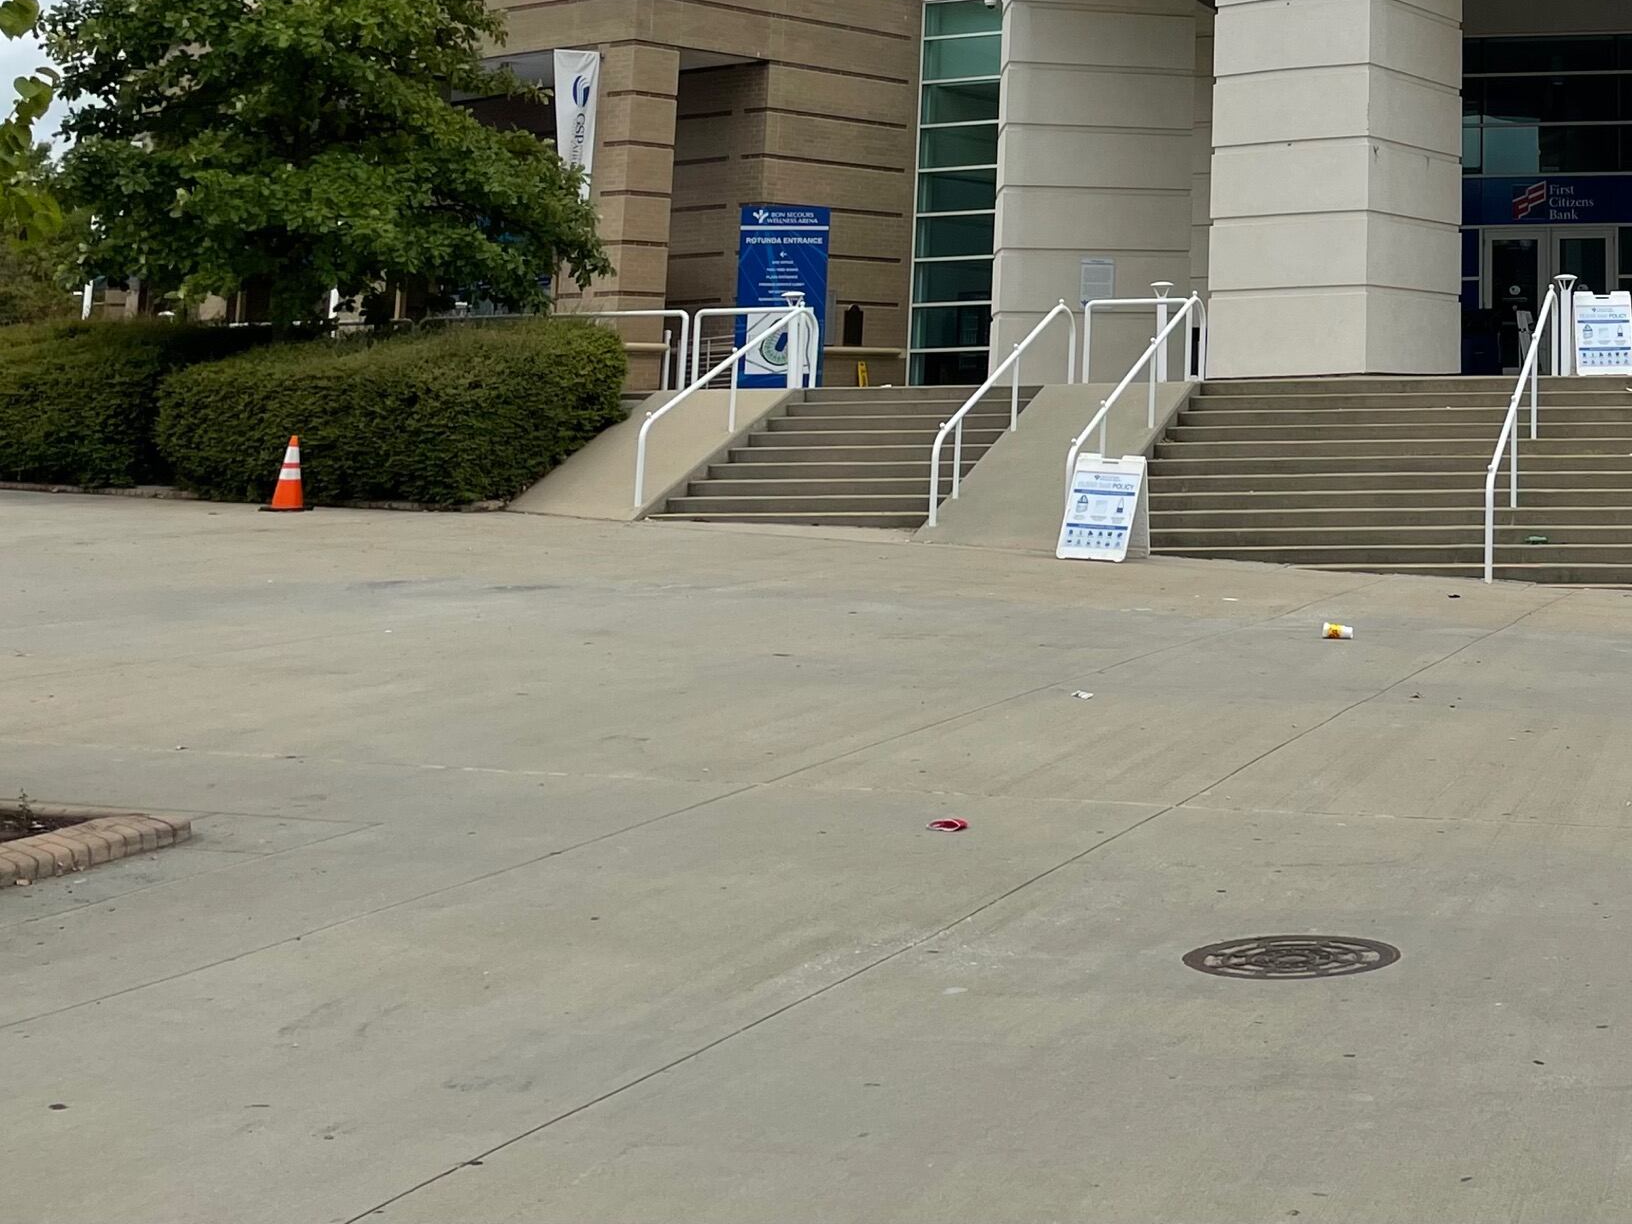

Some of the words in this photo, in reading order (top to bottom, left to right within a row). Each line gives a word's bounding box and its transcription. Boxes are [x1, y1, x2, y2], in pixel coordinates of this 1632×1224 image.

[575, 112, 586, 144] GSP
[1549, 184, 1574, 195] First
[1549, 196, 1594, 207] Citizens
[1549, 208, 1579, 220] Bank
